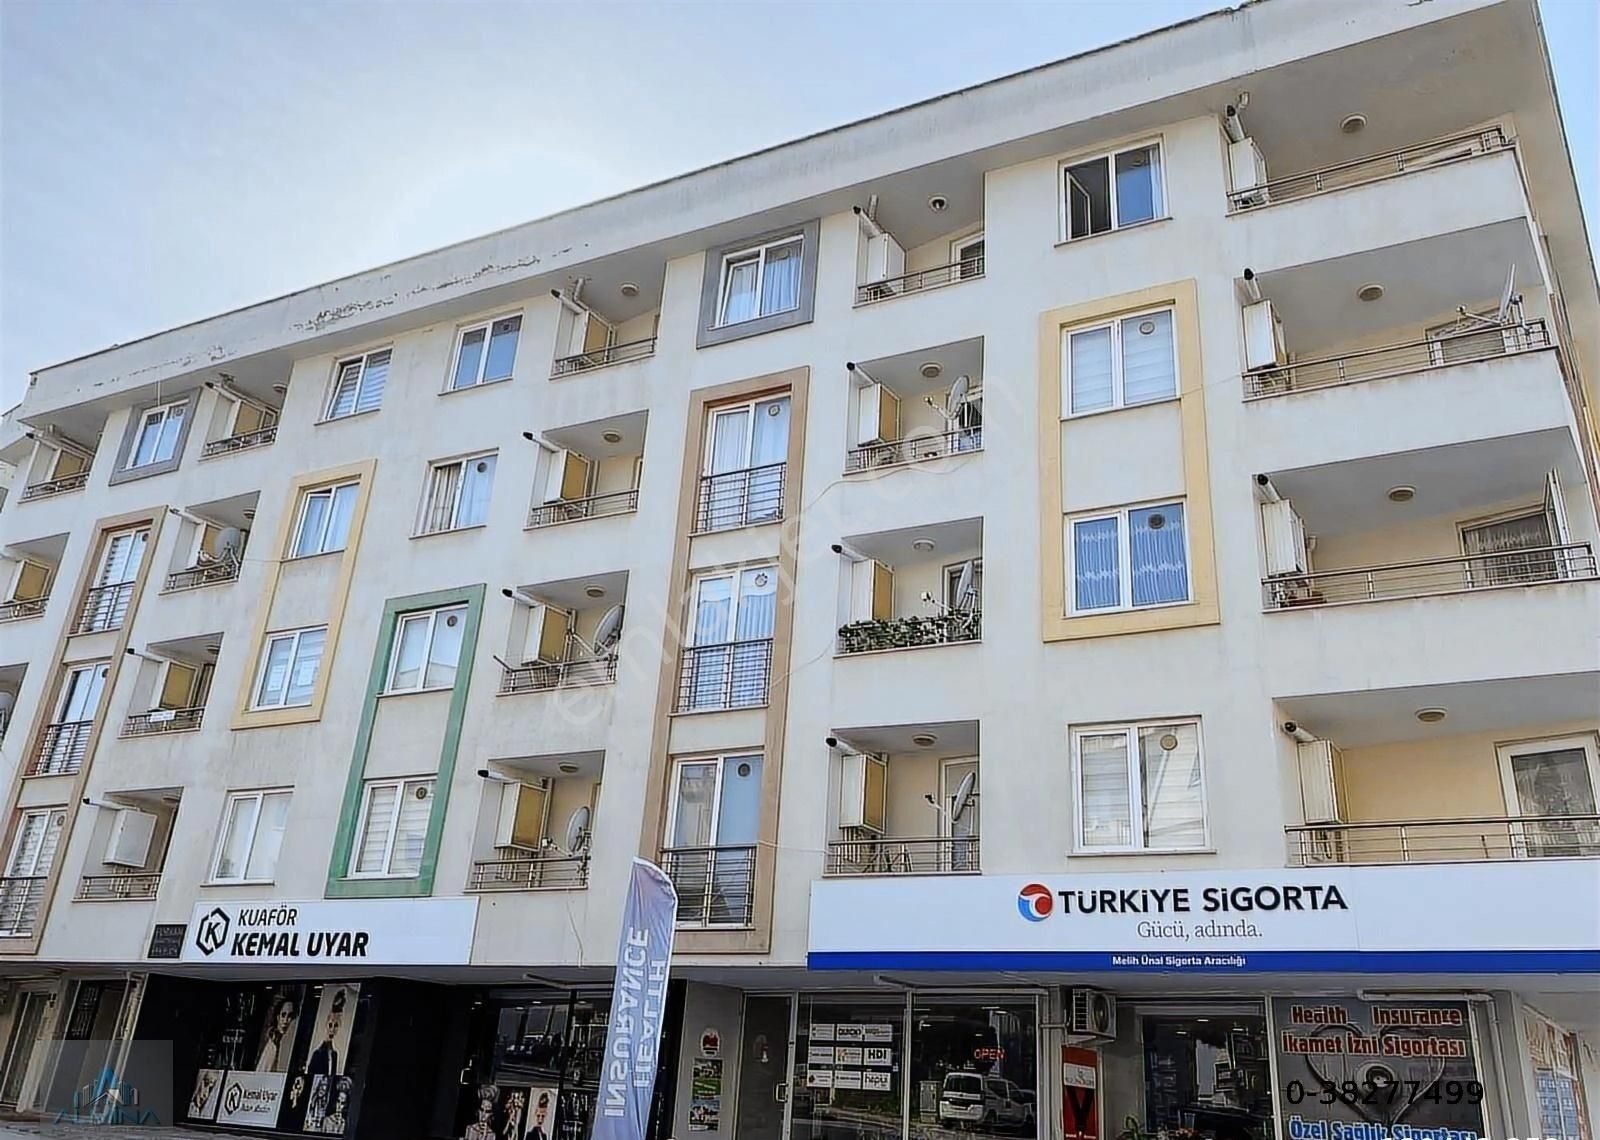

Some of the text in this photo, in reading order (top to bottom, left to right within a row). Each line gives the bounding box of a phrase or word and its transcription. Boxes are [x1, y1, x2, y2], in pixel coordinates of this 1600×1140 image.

[1058, 884, 1349, 914] TÜRKİYE SİGORTA
[238, 902, 298, 927] KUAFÖR
[1137, 919, 1264, 942] Gücü, adında.
[230, 931, 369, 958] KEMAL UYAR
[1112, 954, 1247, 968] Melih Ünal Sigorta Aracılığı
[1290, 1005, 1463, 1026] Health Insurance
[868, 1049, 887, 1060] HDI
[973, 1048, 1005, 1060] OPEN
[1281, 1029, 1467, 1058] İkamet İzni Sigortası
[1289, 1115, 1329, 1139] Özel
